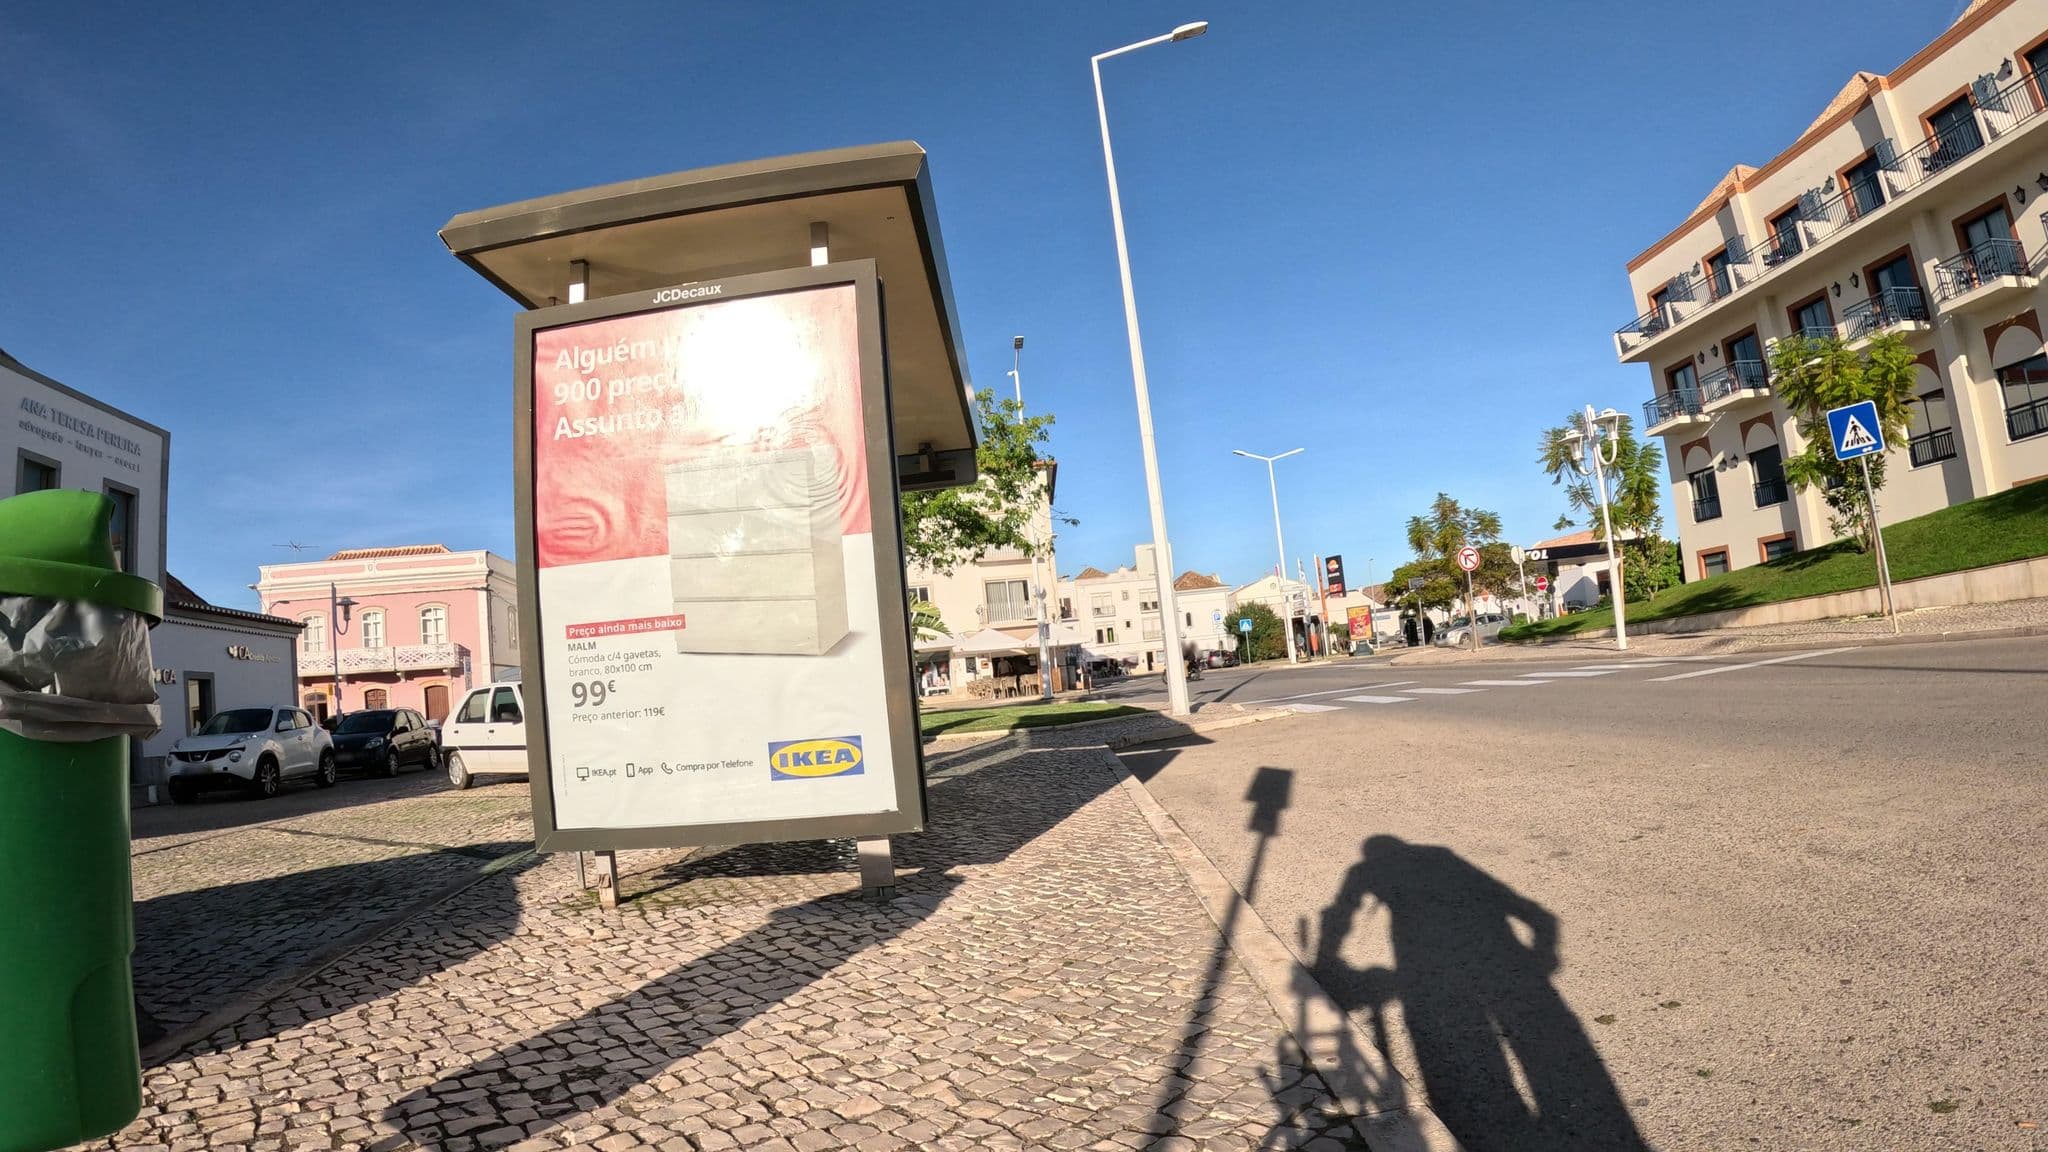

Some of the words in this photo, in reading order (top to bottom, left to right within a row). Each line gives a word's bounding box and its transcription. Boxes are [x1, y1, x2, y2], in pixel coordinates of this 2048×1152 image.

[653, 284, 722, 304] JCDecaux
[555, 337, 657, 375] Alguém
[553, 376, 602, 406] 900
[20, 396, 48, 420] ANA
[50, 407, 96, 439] TERESA
[96, 426, 142, 457] PEREIRA
[554, 399, 663, 440] Assunto
[569, 627, 596, 638] Preço
[598, 623, 626, 635] ainda
[628, 620, 652, 632] mais
[655, 617, 682, 629] baixo
[567, 641, 597, 652] MALM
[568, 653, 605, 665] Cómoda
[607, 651, 621, 662] c/4
[623, 649, 662, 663] gavetas,
[569, 666, 602, 678] branco,
[604, 662, 637, 675] 80x100
[638, 663, 653, 672] cm
[571, 679, 617, 708] 99€
[572, 712, 598, 724] Preço
[600, 709, 642, 721] anterior:
[644, 706, 665, 718] 119€
[676, 761, 706, 774] Compra
[706, 762, 719, 771] por
[721, 759, 754, 769] Telefone
[779, 748, 855, 768] IKEA
[638, 766, 653, 776] App
